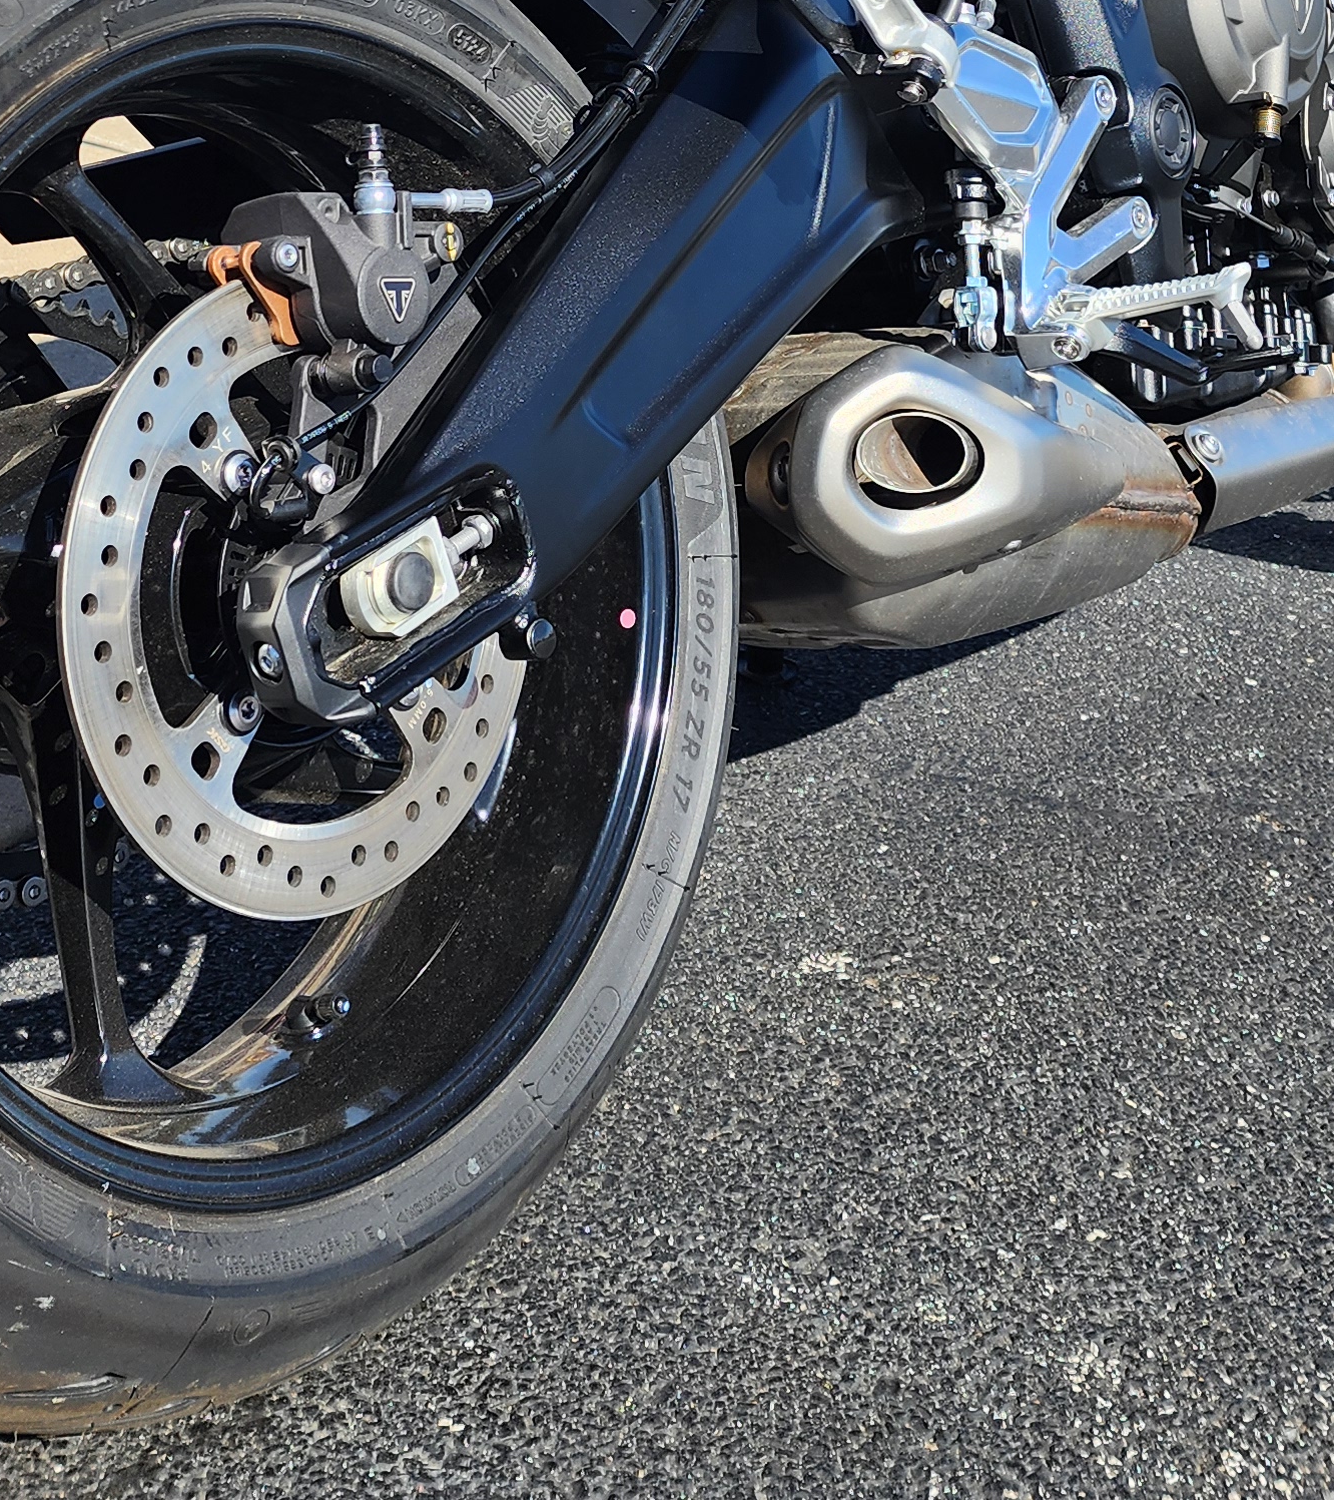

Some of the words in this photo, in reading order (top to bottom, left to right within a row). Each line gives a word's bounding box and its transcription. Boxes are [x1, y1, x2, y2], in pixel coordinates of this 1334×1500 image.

[691, 575, 716, 702] 180/55
[680, 712, 706, 765] ZR
[671, 777, 694, 816] 17
